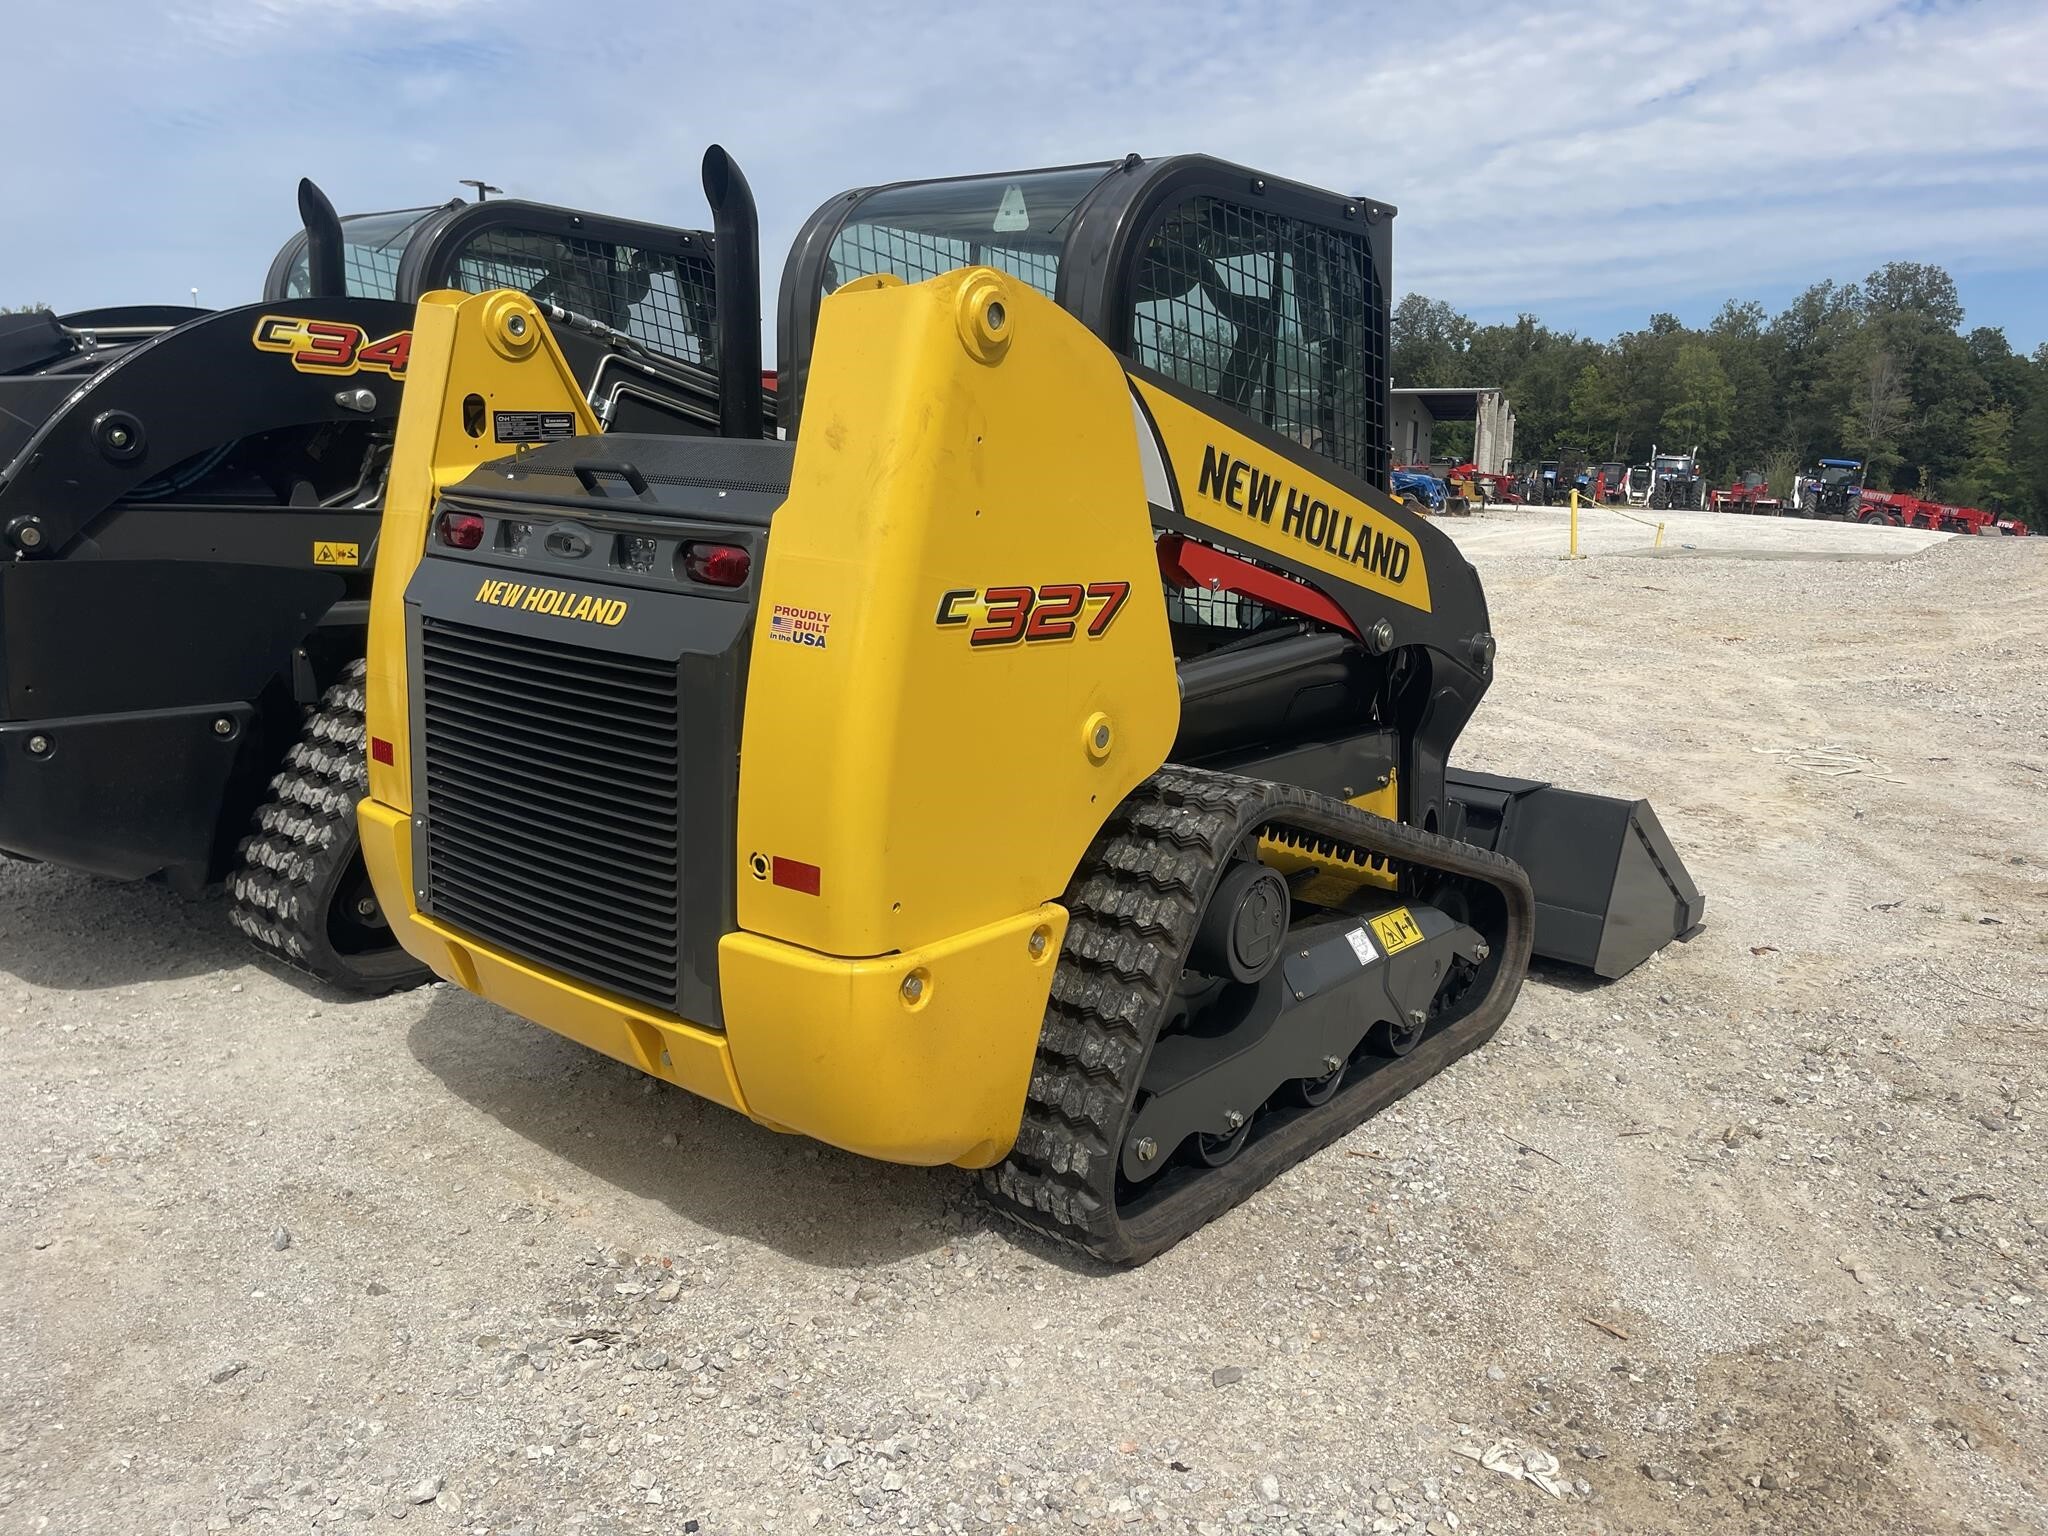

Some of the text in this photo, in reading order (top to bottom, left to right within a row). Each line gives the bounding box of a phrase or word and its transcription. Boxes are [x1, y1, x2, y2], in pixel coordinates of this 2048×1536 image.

[1198, 443, 1411, 585] NEW HOLLAND
[475, 579, 629, 627] NEW HOLLAND
[774, 605, 831, 622] PROUDLY
[935, 581, 1131, 647] C327
[769, 630, 826, 648] in the USA
[794, 619, 830, 634] BUILT
